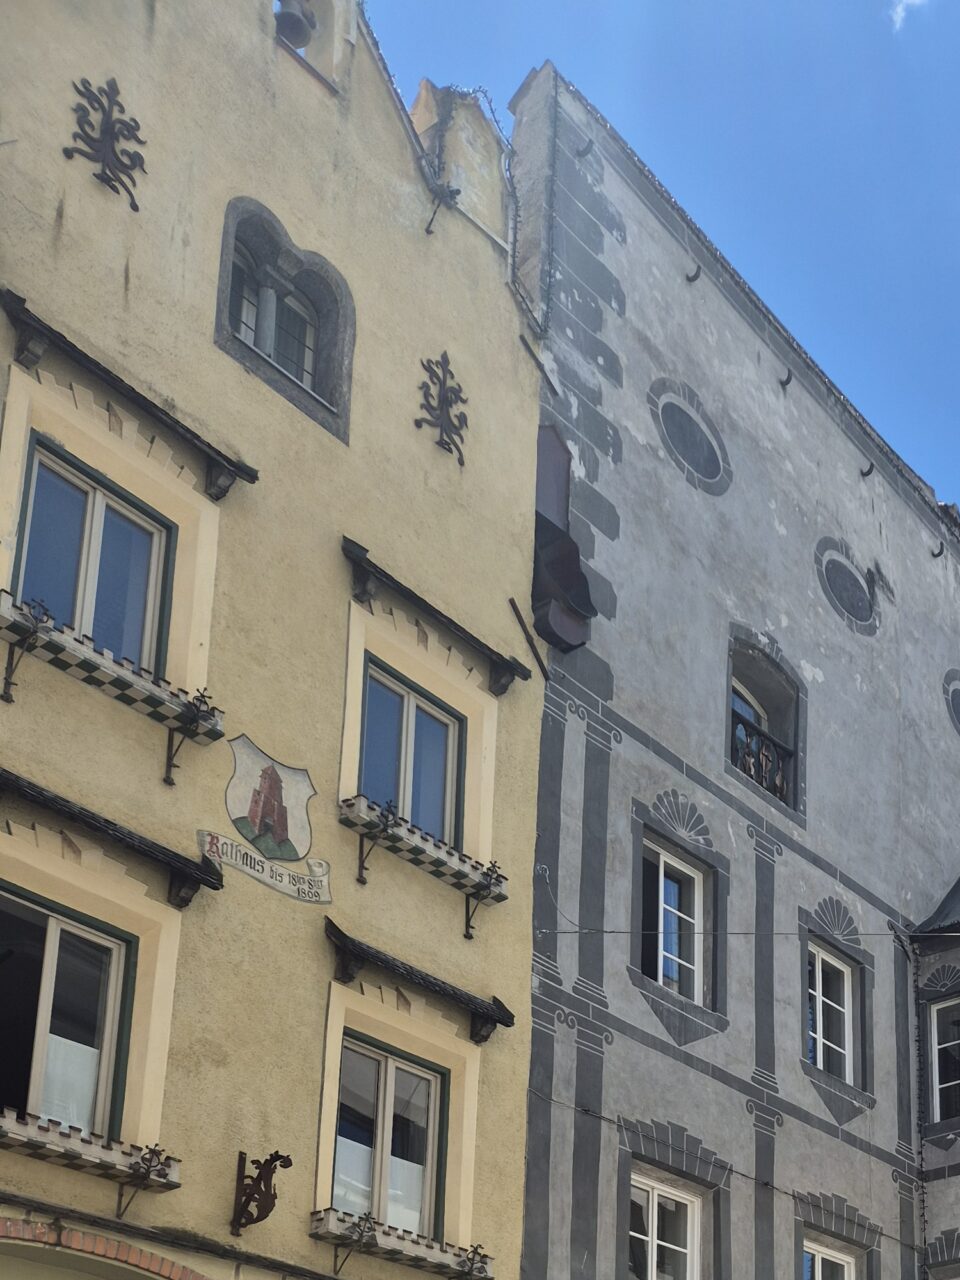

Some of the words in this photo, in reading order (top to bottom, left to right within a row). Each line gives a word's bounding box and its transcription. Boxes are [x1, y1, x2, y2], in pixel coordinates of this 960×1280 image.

[207, 832, 266, 875] Rathaus
[269, 865, 284, 883] bis
[297, 887, 320, 901] 1809
